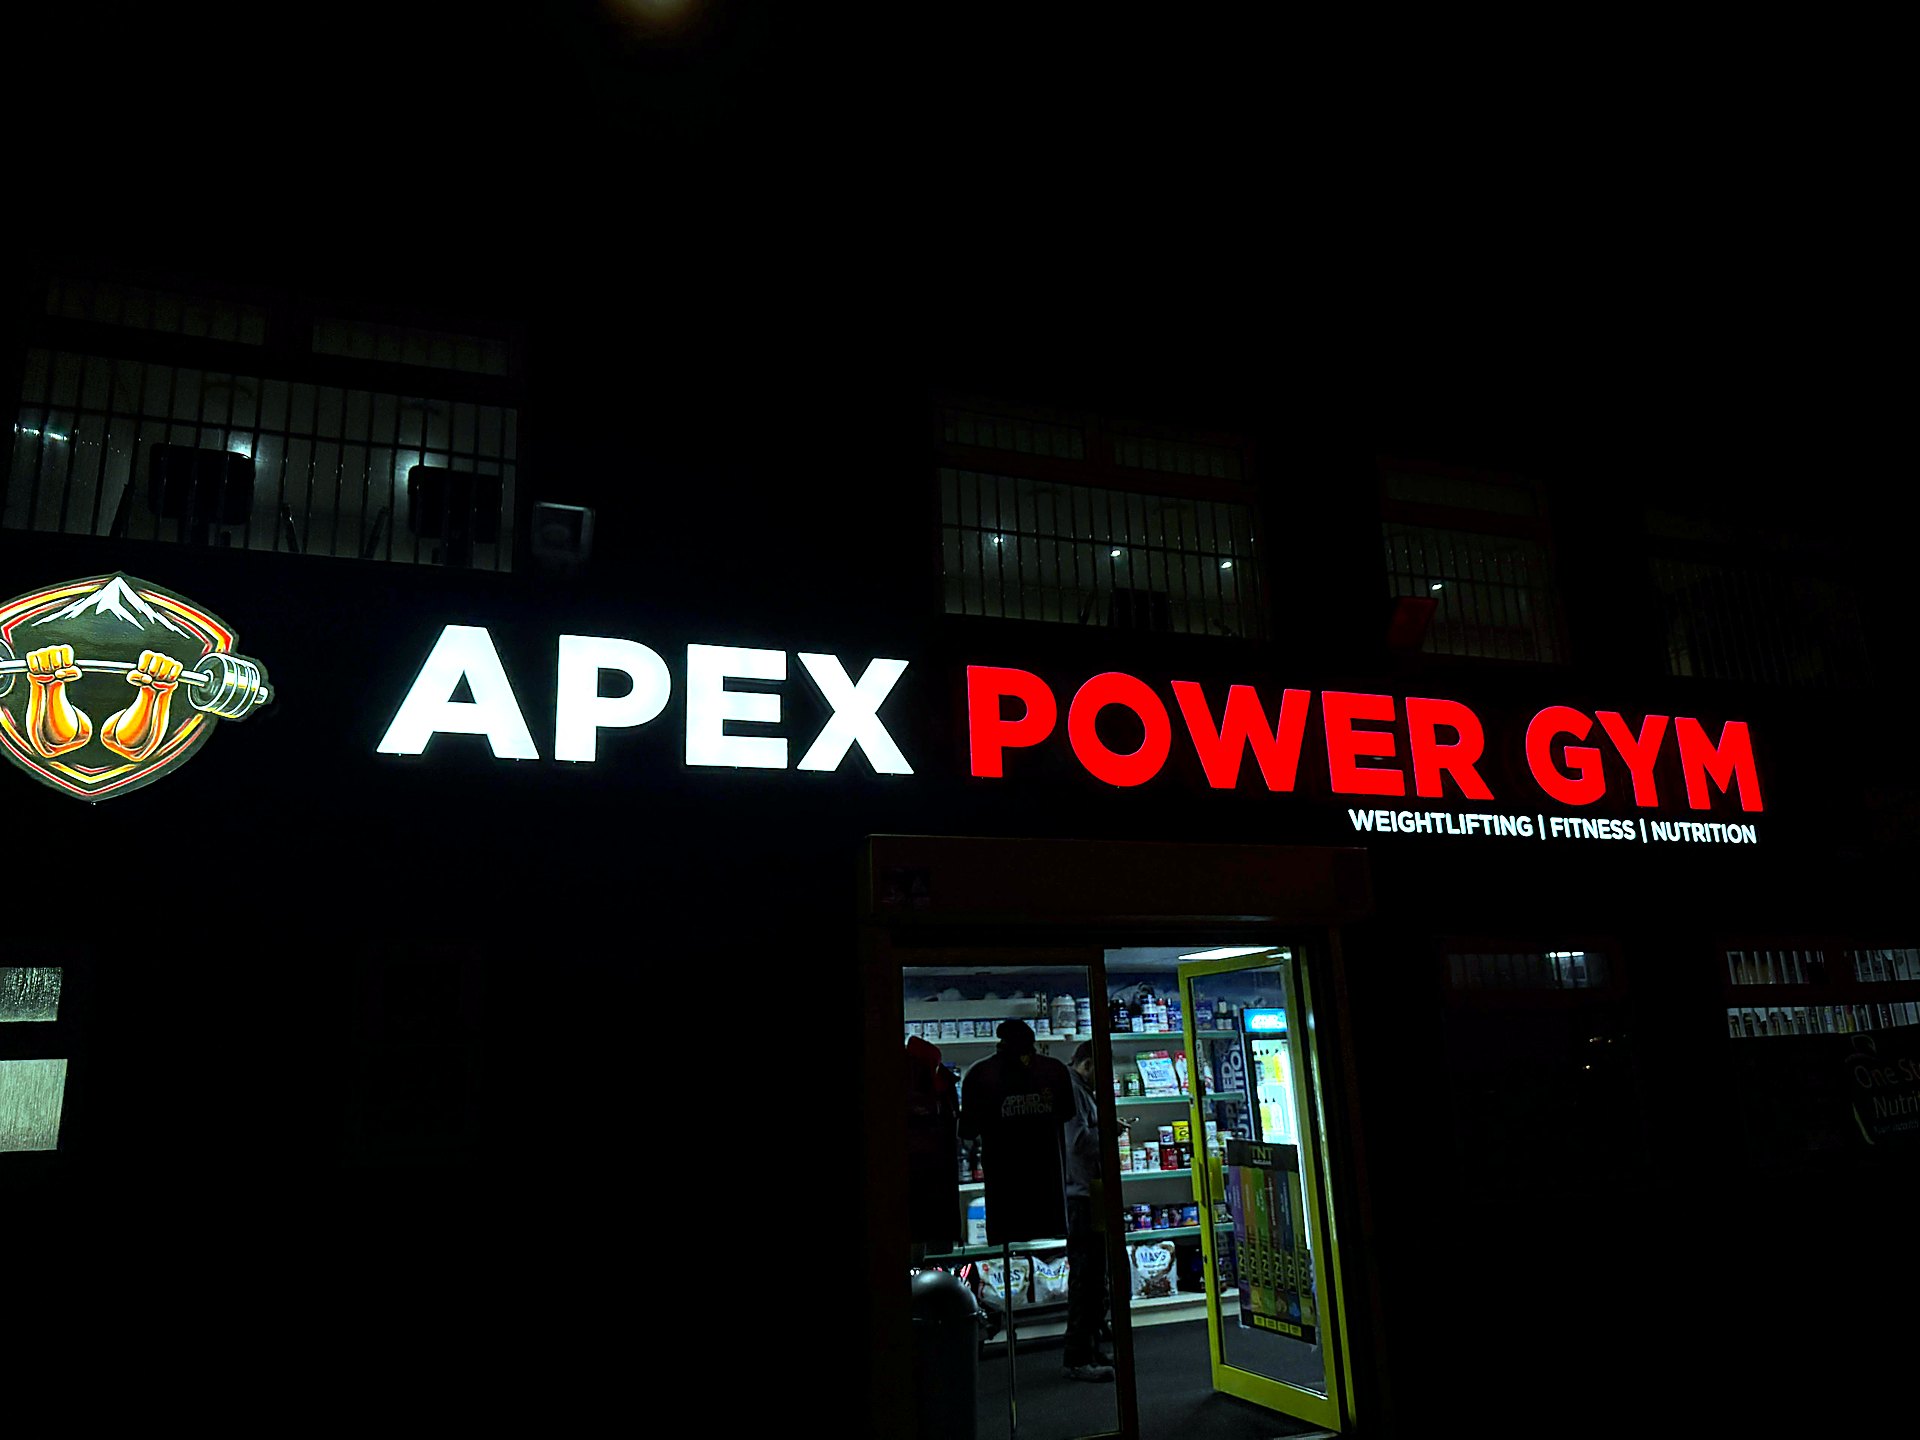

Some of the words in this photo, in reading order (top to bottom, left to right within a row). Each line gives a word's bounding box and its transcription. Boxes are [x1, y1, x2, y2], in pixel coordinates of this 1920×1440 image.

[377, 625, 914, 774] APEX
[967, 665, 1494, 801] POWER
[1526, 706, 1763, 813] GYM
[1348, 809, 1533, 836] WEIGHTLIFTING
[1550, 817, 1635, 840] FITNESS
[1651, 821, 1757, 844] NUTRITION
[1854, 1065, 1899, 1088] One
[1001, 1102, 1052, 1118] NUTRITION
[1004, 1093, 1040, 1105] APPLIED
